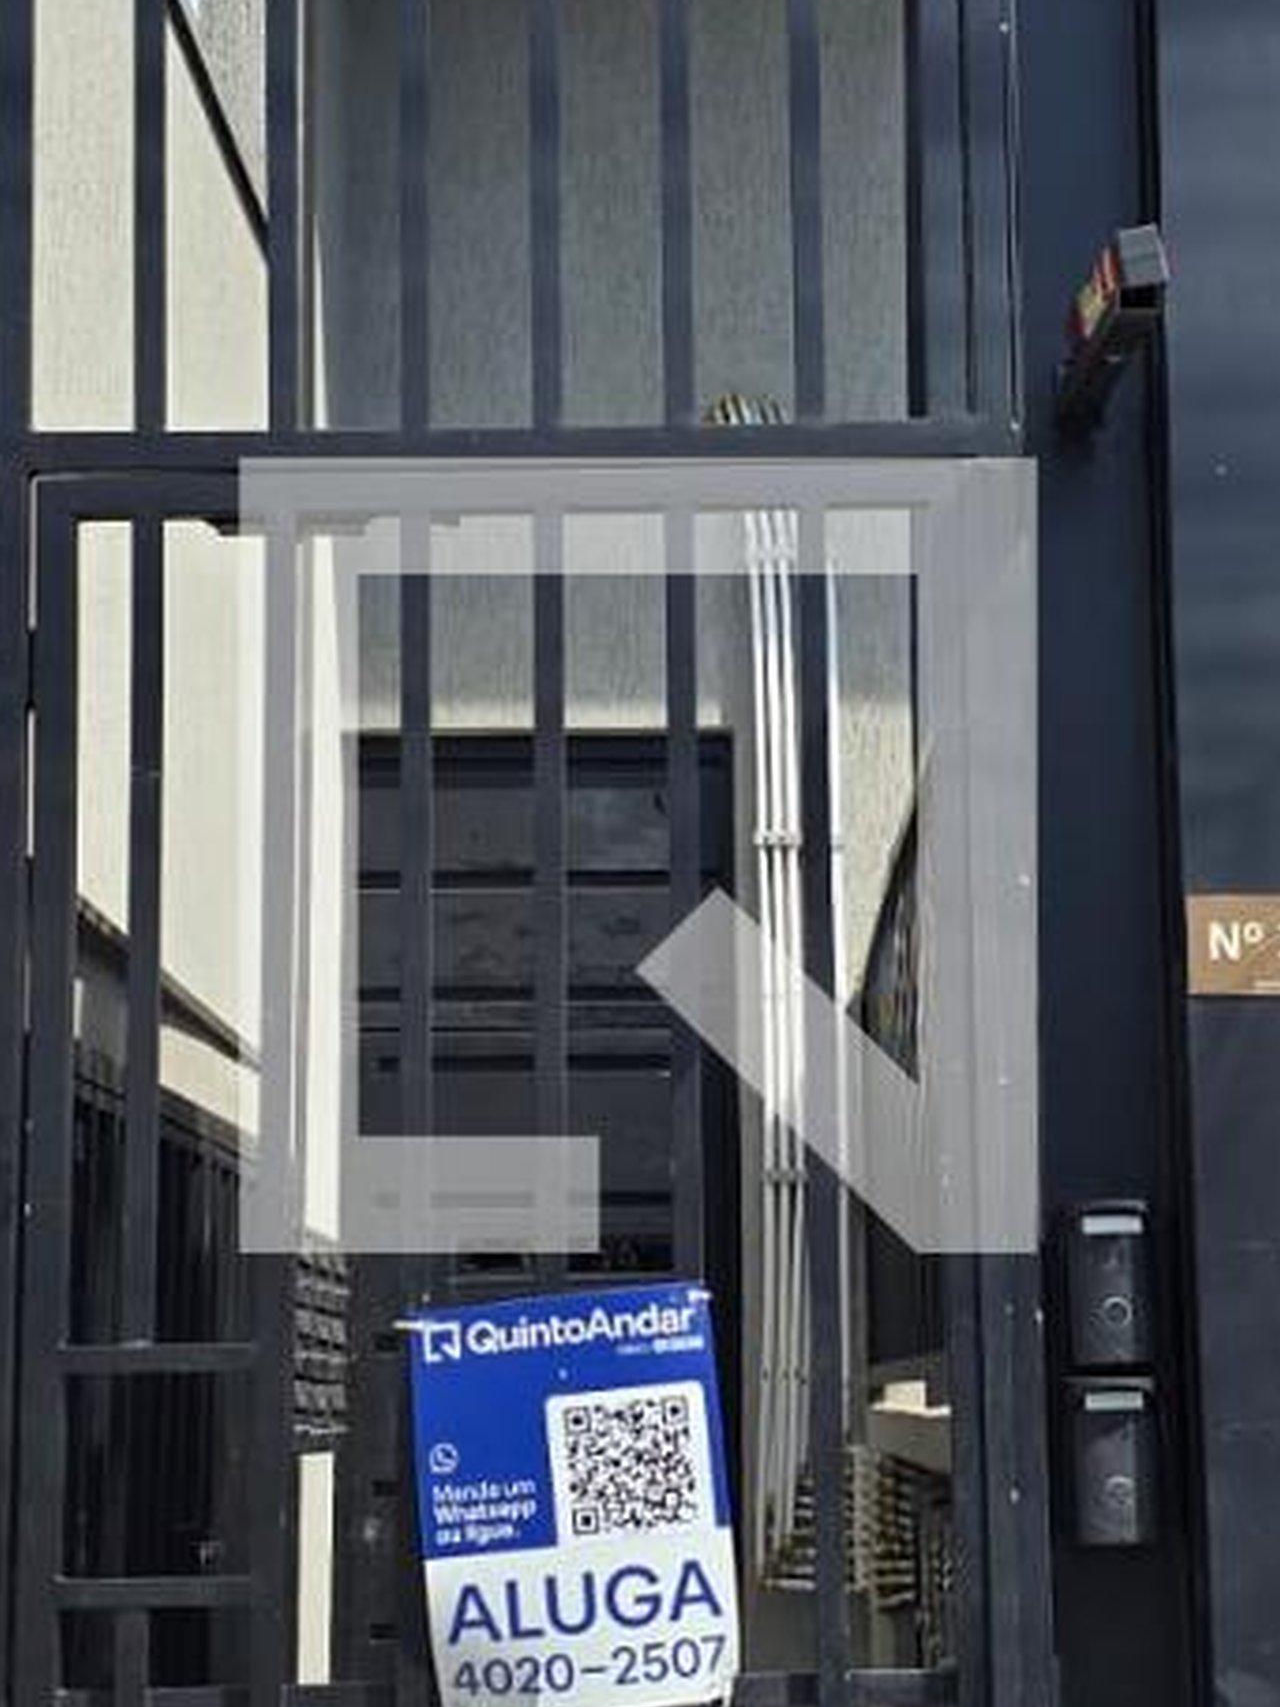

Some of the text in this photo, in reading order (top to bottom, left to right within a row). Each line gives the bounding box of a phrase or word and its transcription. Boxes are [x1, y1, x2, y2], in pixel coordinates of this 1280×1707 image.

[1209, 920, 1263, 961] Nº
[465, 1304, 697, 1355] QuintoAndar
[447, 1558, 723, 1645] ALUGA
[454, 1634, 726, 1695] 4020-2507
